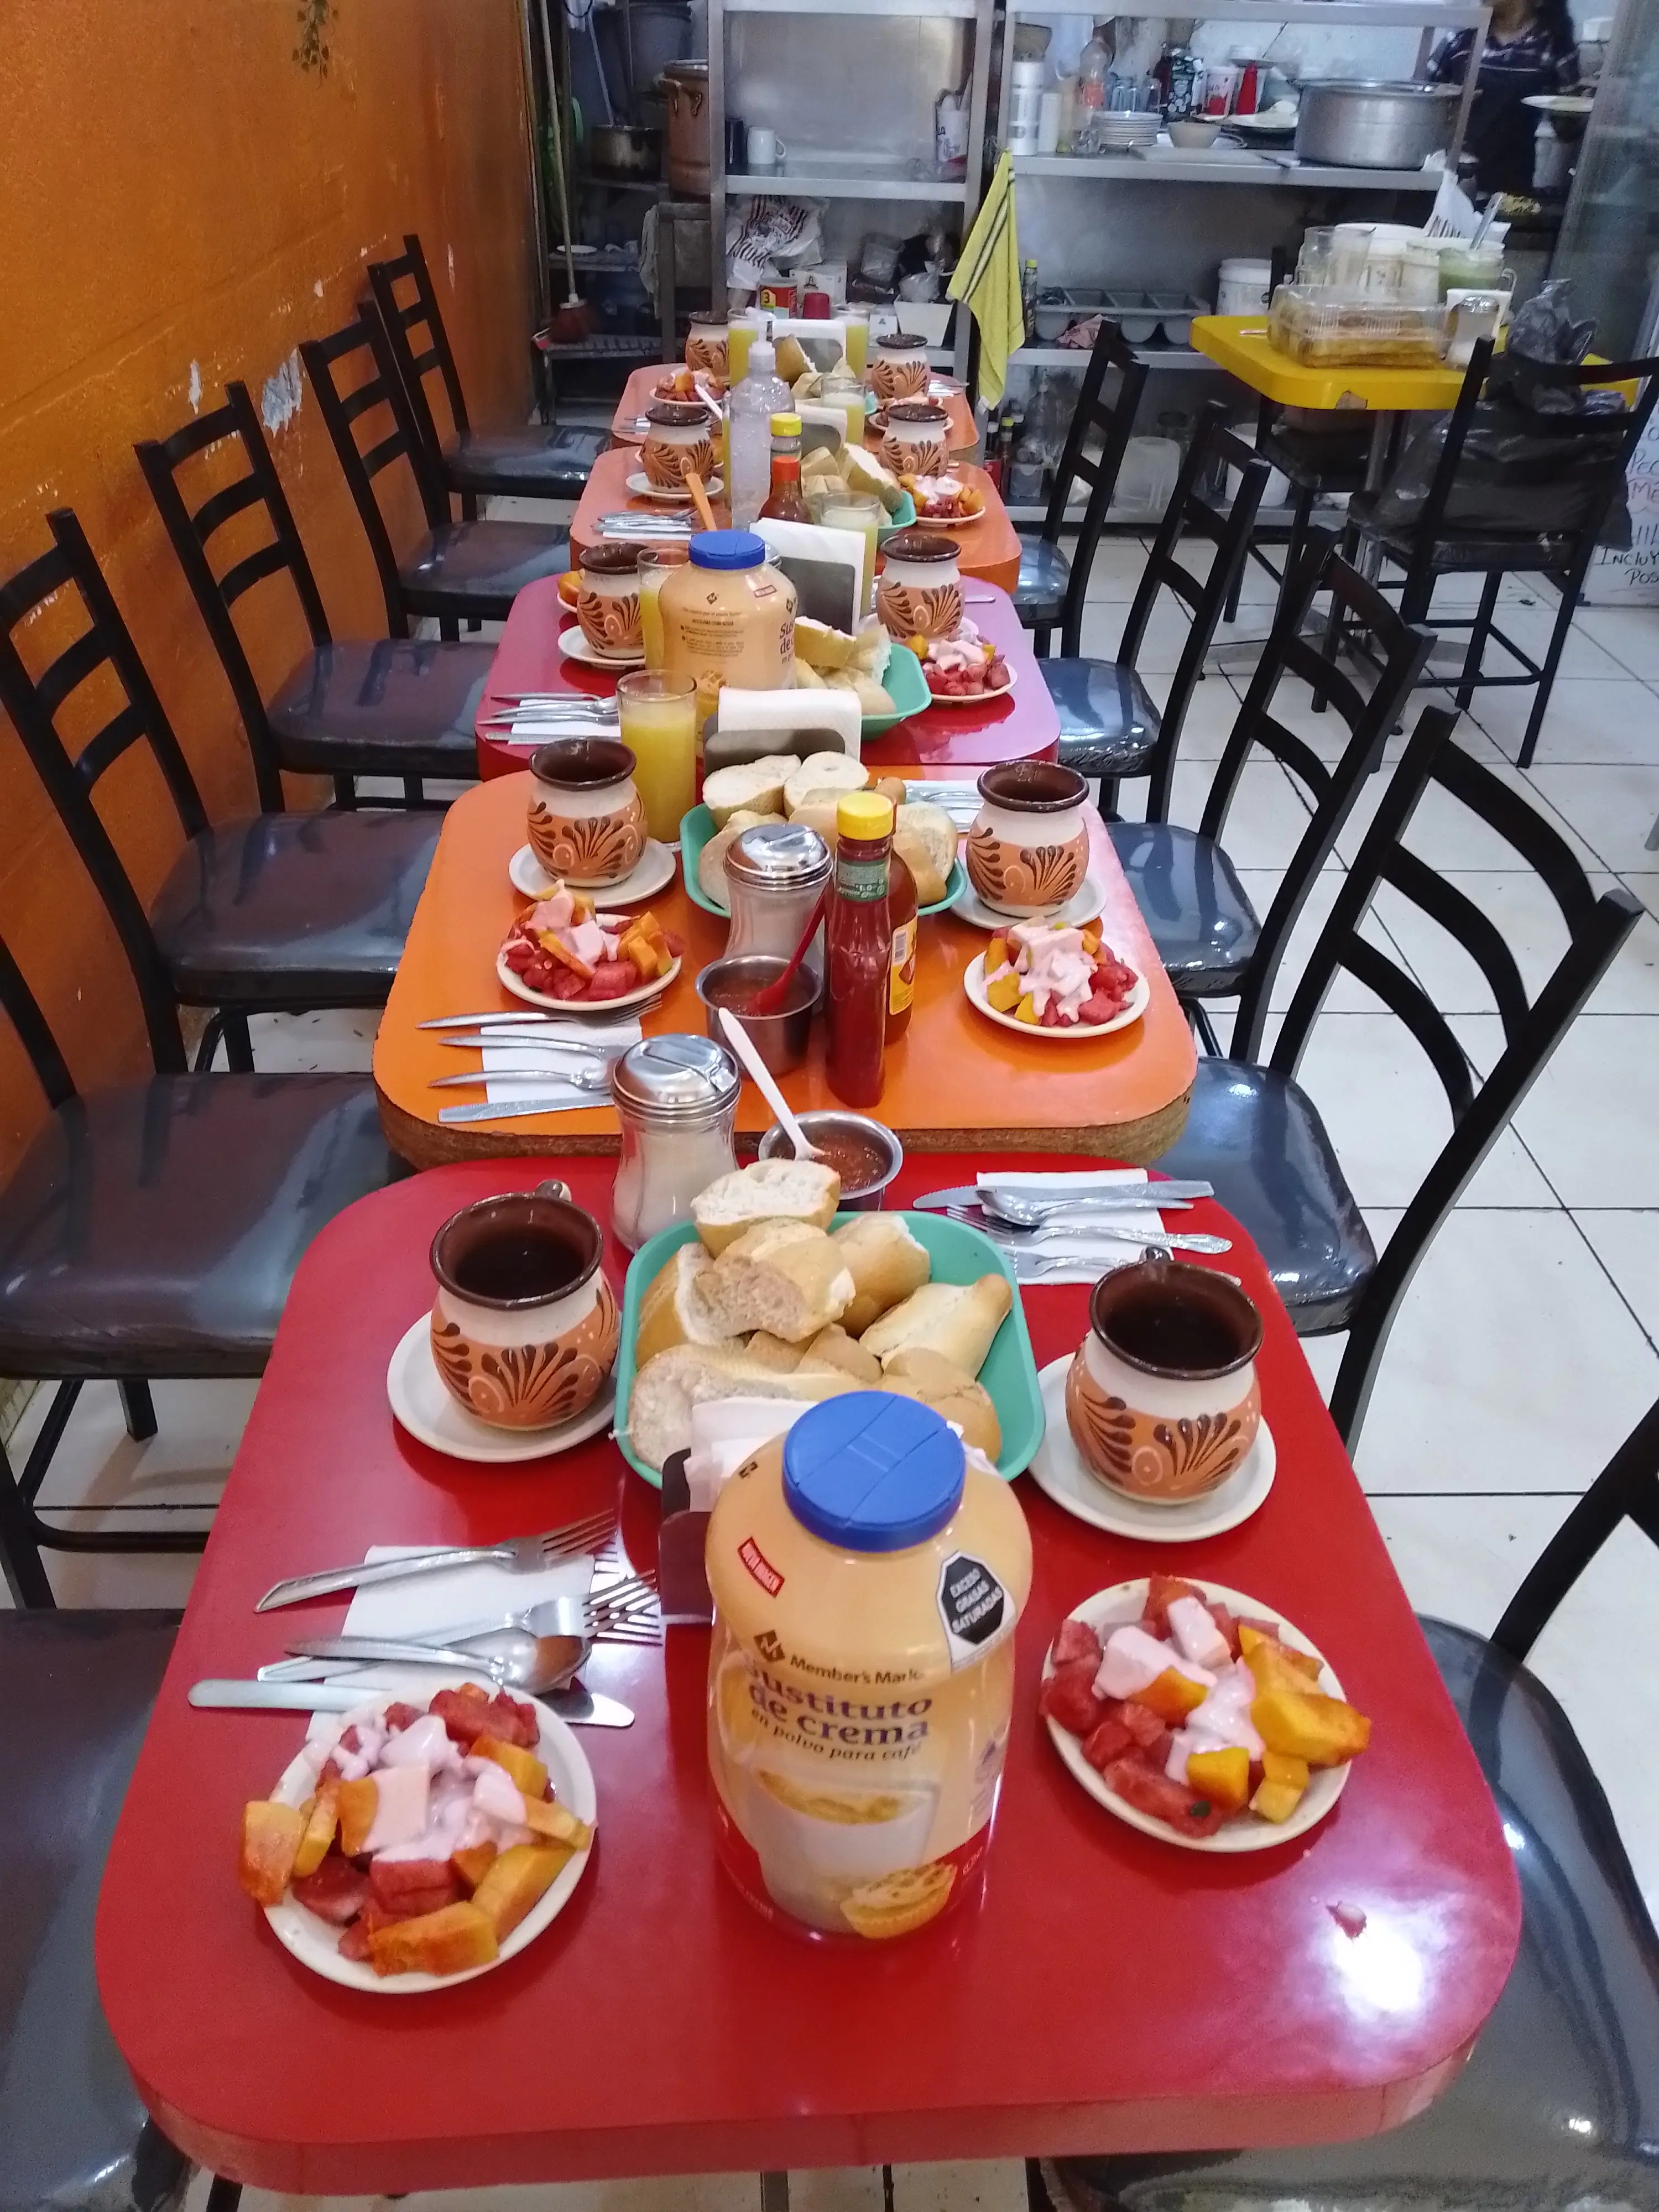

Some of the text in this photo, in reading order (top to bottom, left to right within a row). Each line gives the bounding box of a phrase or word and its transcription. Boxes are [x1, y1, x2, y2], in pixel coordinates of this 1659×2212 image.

[764, 292, 770, 304] 3
[951, 1586, 1003, 1634] SATURADAS
[790, 1654, 870, 1684] Member's
[875, 1667, 925, 1684] Mark
[749, 1685, 928, 1745] de crema
[752, 1709, 768, 1729] en
[774, 1725, 824, 1754] polvo
[830, 1747, 875, 1760] para
